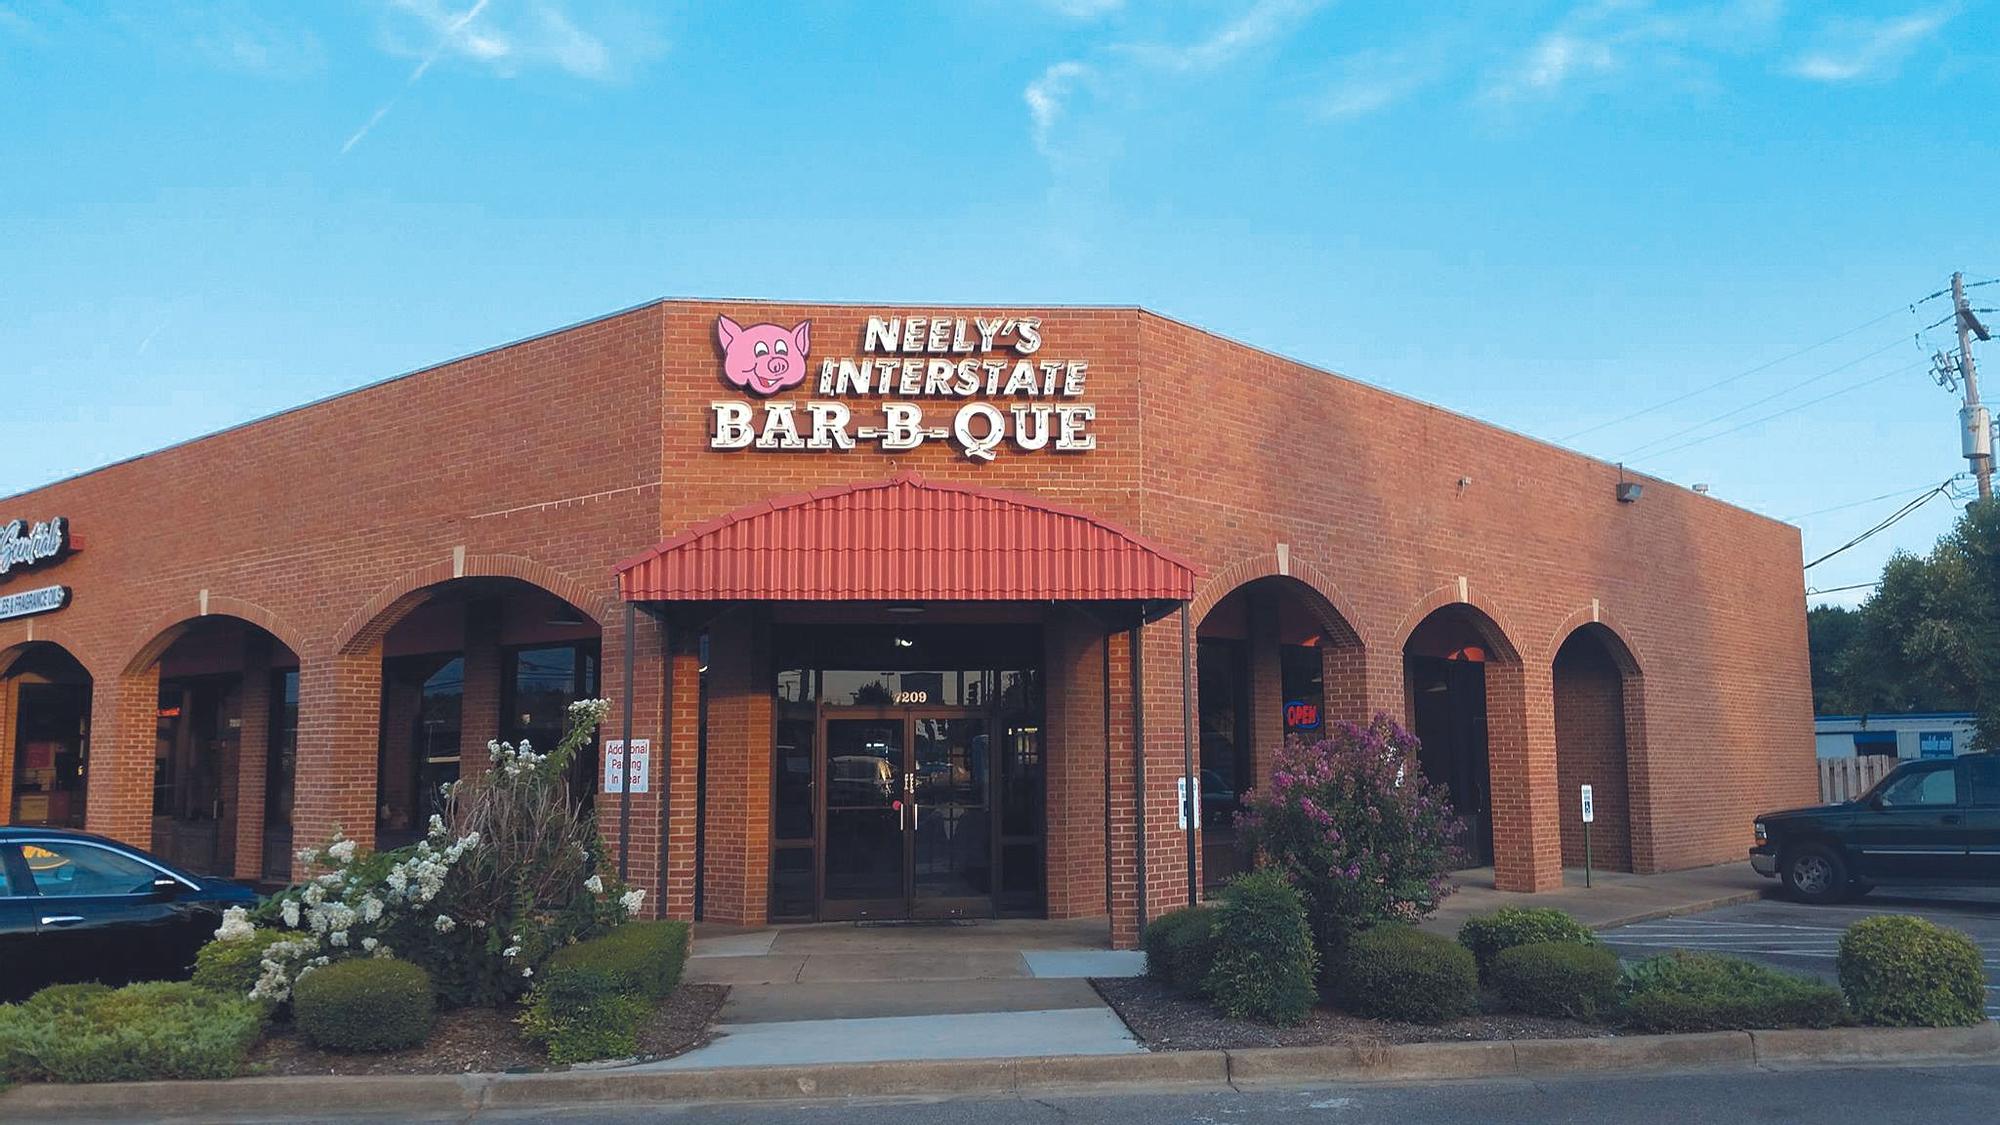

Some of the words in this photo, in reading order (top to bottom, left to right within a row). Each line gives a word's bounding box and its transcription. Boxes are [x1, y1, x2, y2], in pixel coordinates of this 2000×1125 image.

[864, 315, 1042, 354] NEELY'S
[819, 357, 1089, 397] INTERSTATE
[711, 401, 1097, 461] BAR-B-QUE
[892, 691, 928, 704] 7209
[1287, 704, 1317, 726] OPEN
[608, 744, 648, 755] Addonal
[611, 759, 642, 771] Pang
[611, 775, 619, 784] In
